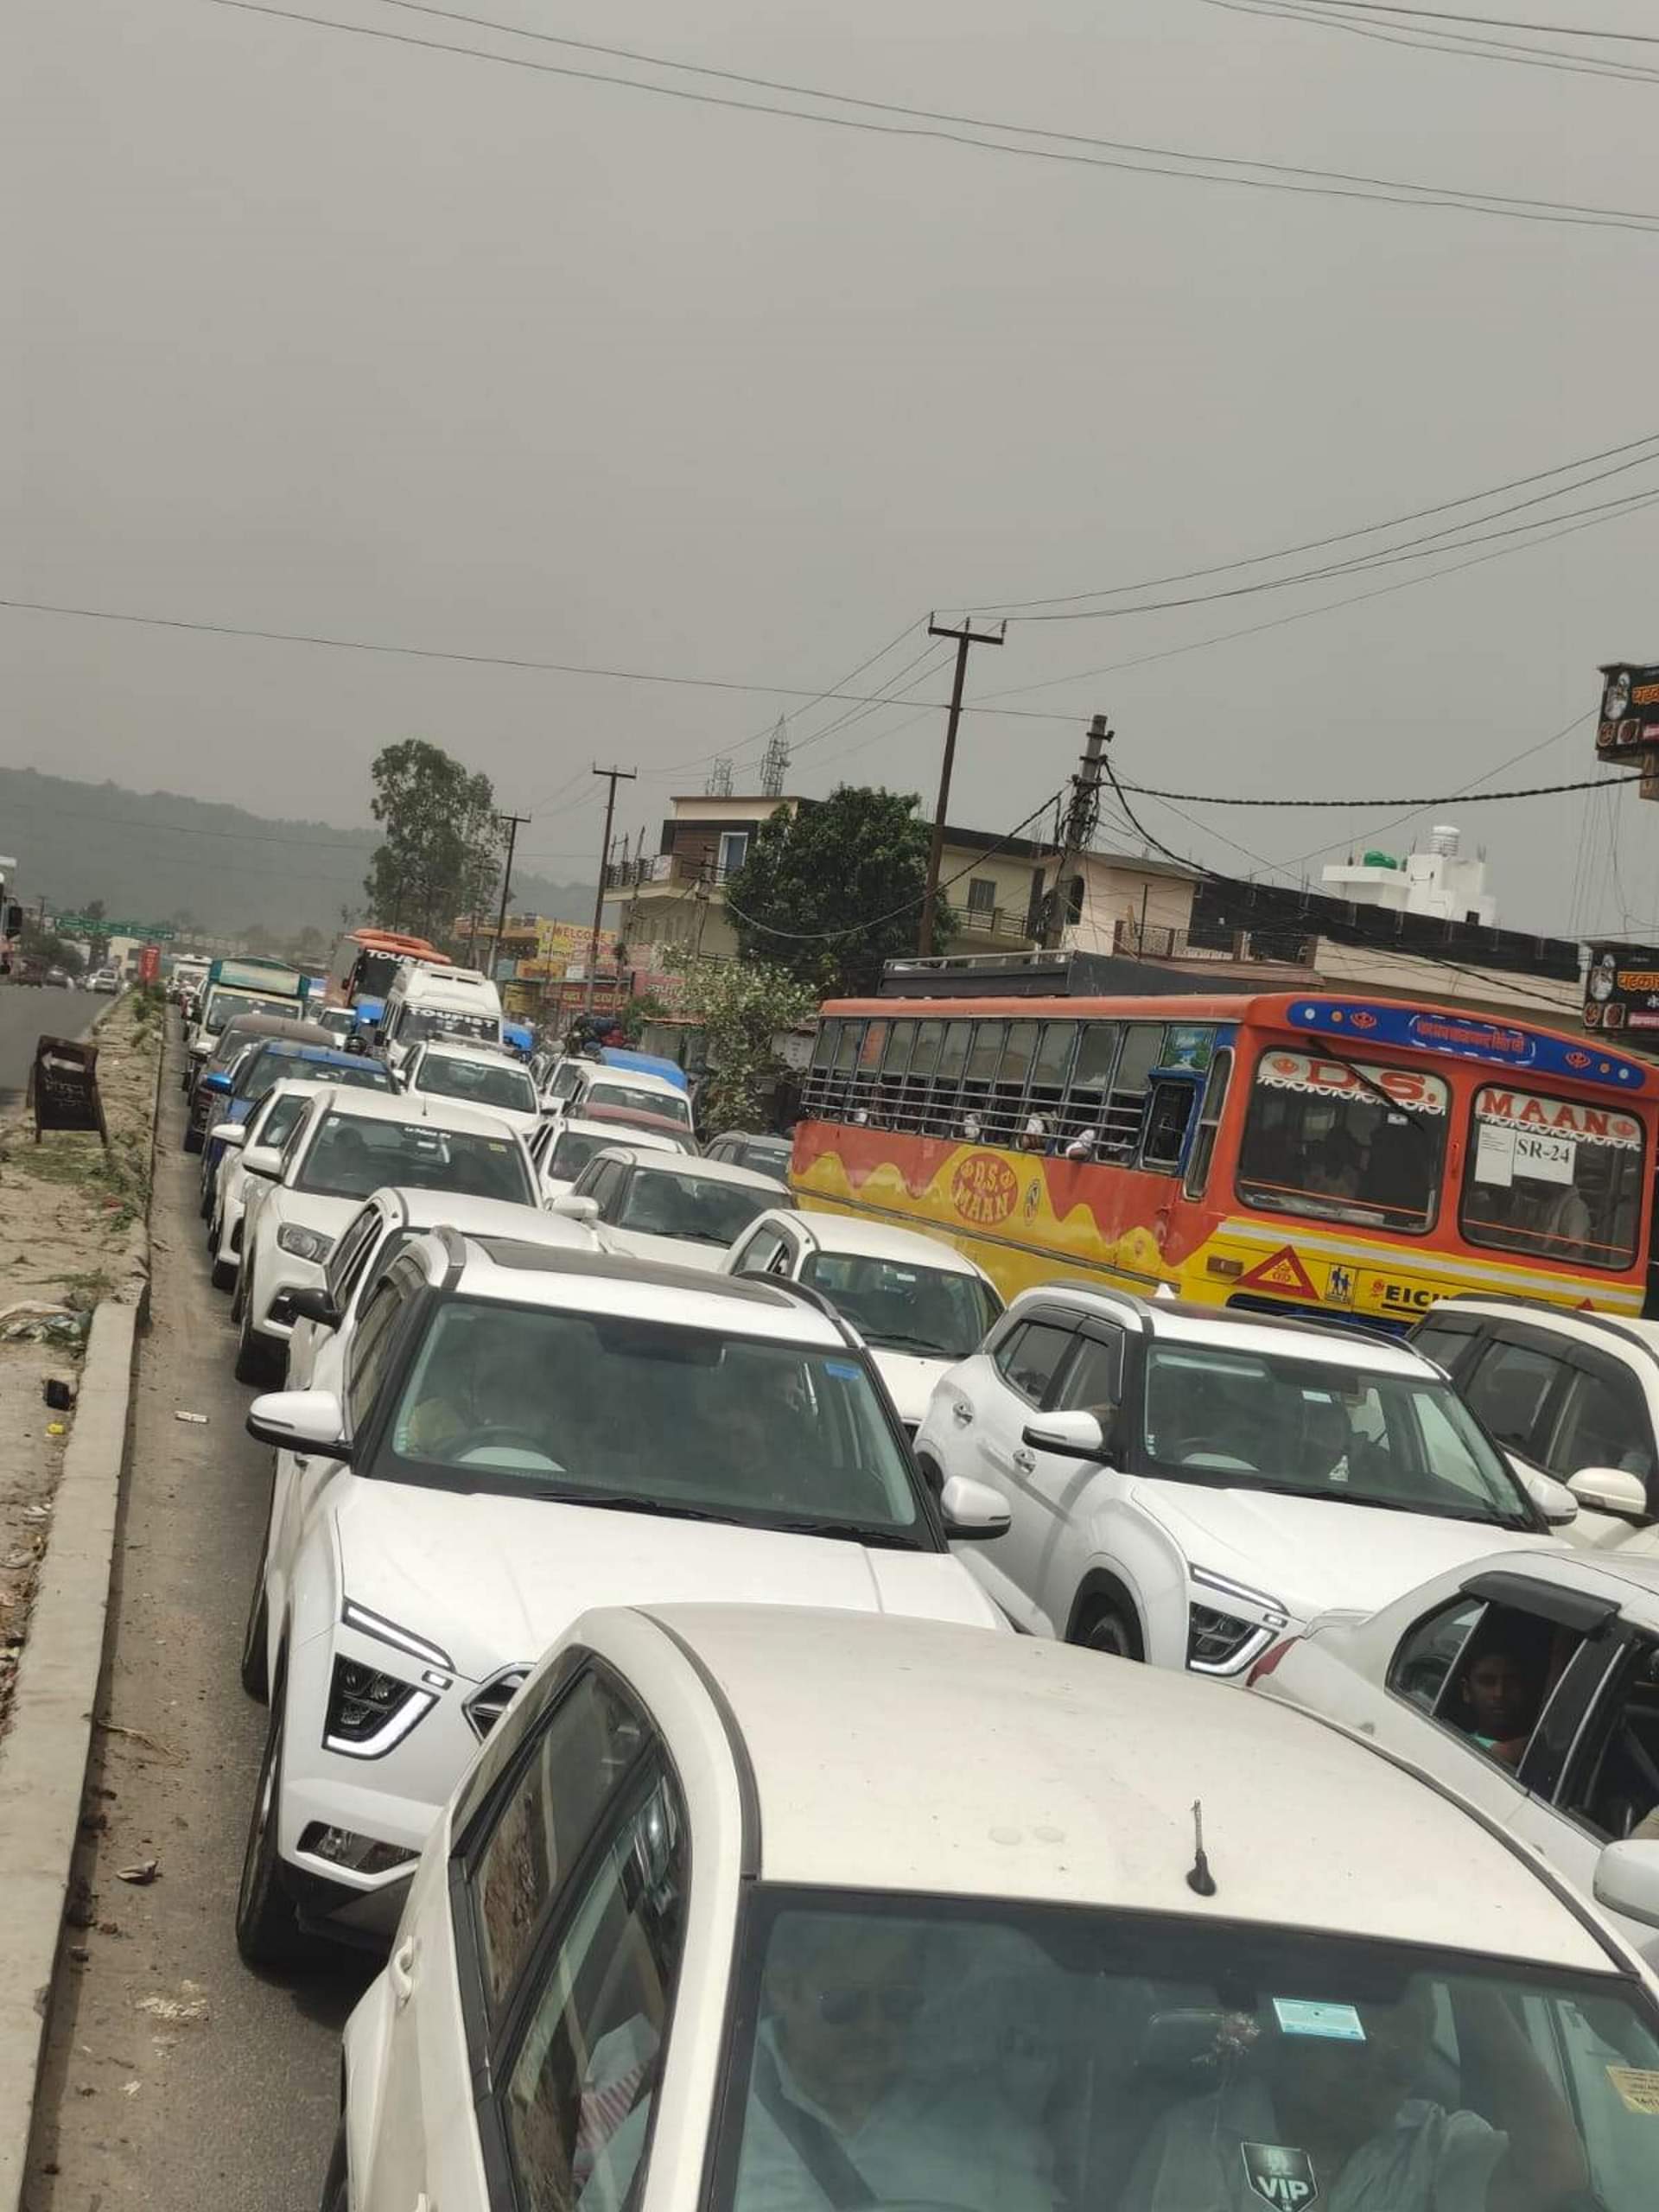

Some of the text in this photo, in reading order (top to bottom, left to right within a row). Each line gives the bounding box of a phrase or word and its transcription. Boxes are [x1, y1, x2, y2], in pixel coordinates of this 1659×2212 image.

[553, 925, 608, 941] WELCOE
[410, 1007, 496, 1028] TOURIST
[1484, 1090, 1611, 1136] MAAN
[1517, 1139, 1570, 1164] SR-24
[1257, 2176, 1309, 2201] VIP
